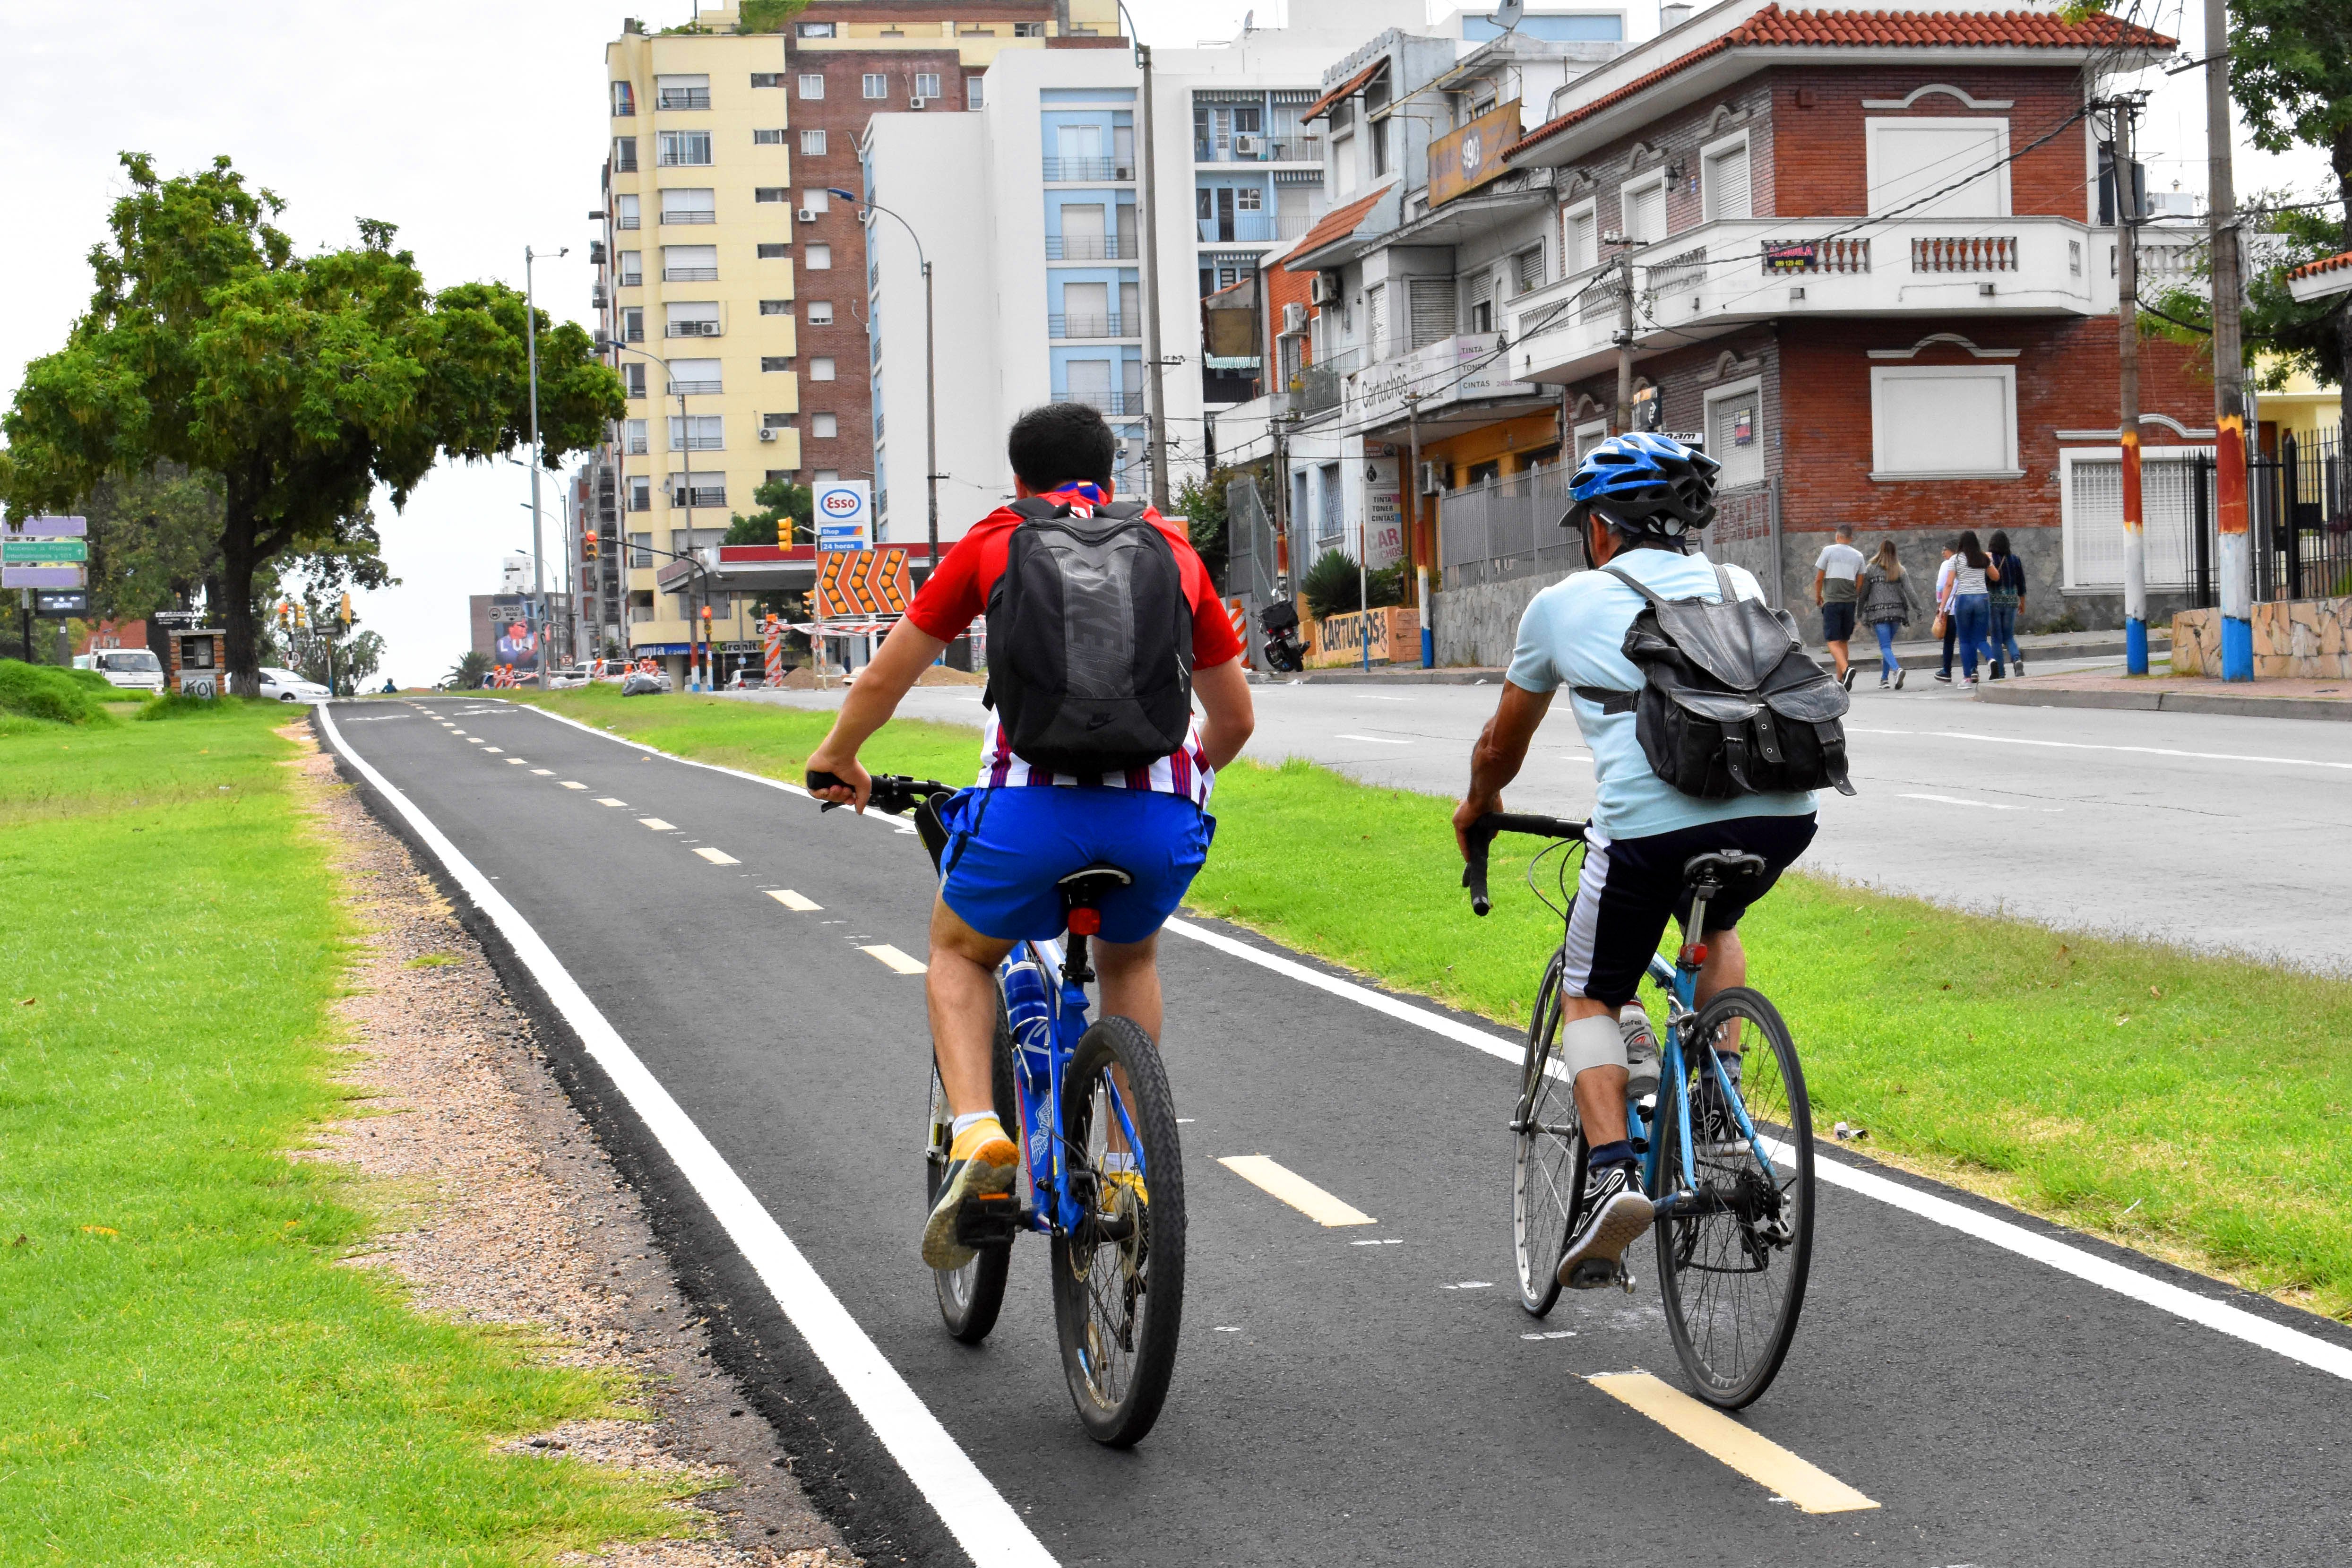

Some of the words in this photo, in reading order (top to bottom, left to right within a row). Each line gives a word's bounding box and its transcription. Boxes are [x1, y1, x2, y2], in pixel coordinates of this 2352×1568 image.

[1461, 346, 1483, 354] TINTA
[1362, 370, 1408, 408] Cartuchos
[1463, 380, 1490, 388] CINTAS
[827, 497, 855, 508] Esso
[1323, 611, 1379, 652] CARTUCHOS
